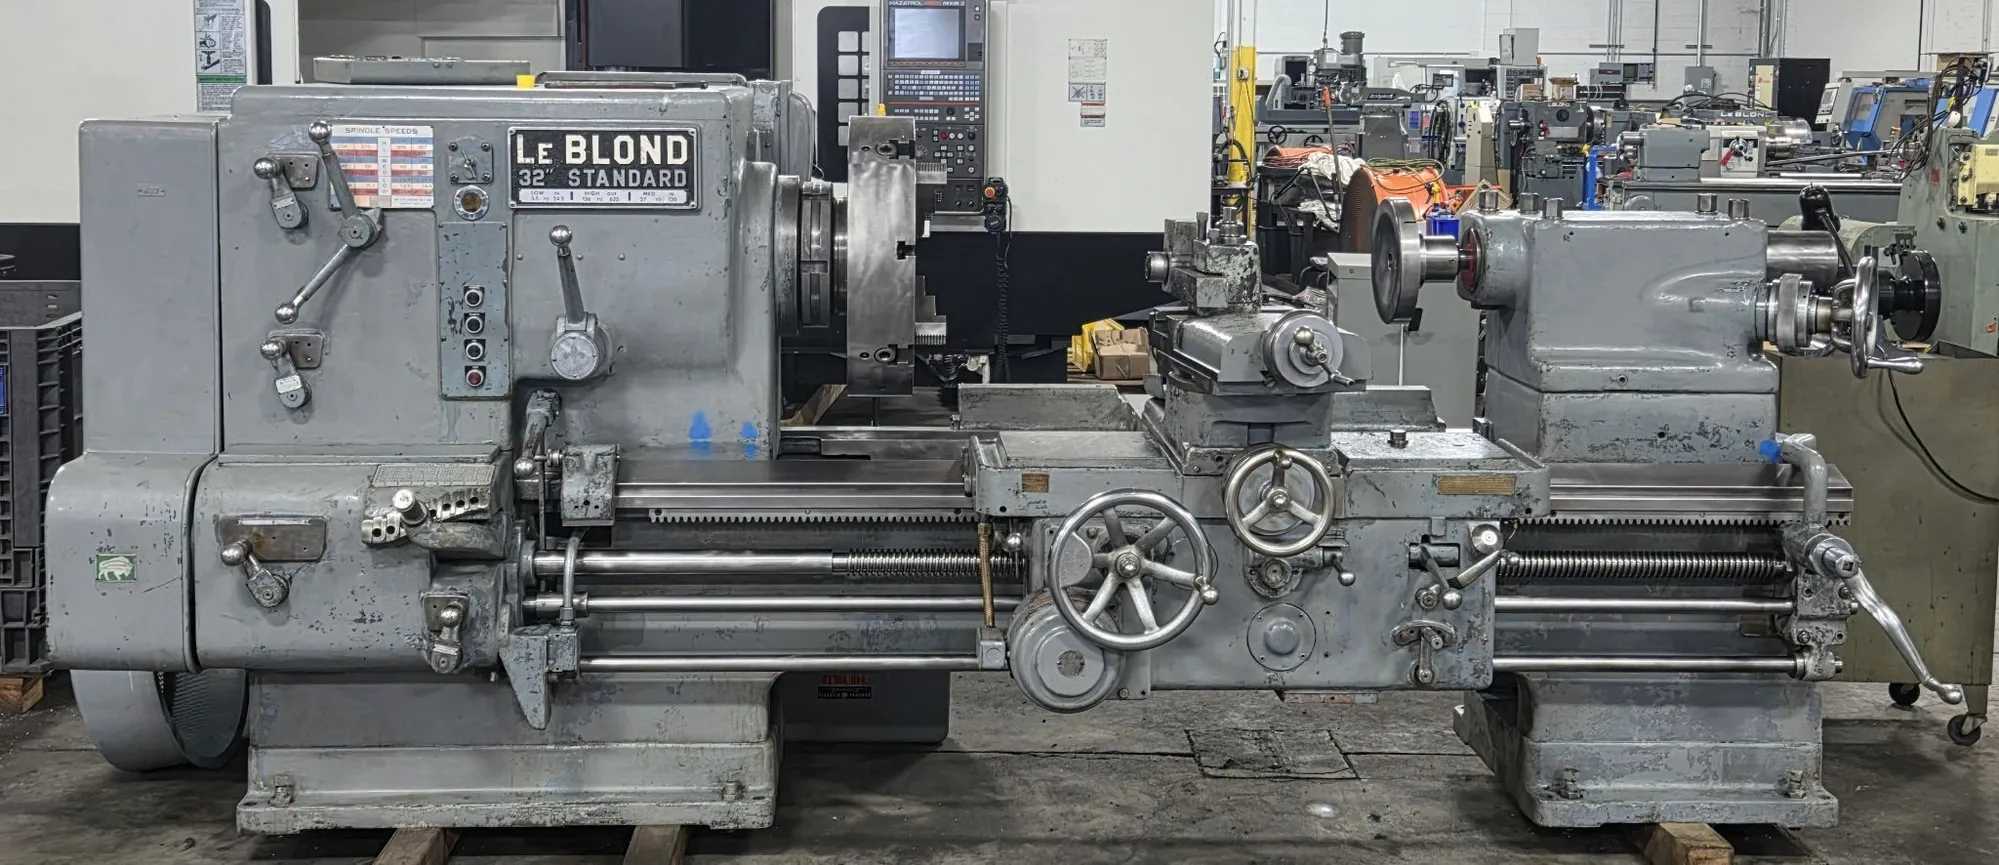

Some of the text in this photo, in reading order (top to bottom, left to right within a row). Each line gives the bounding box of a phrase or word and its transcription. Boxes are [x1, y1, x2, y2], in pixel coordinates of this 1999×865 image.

[565, 134, 688, 165] BLOND
[518, 169, 687, 187] 32" STANDARD
